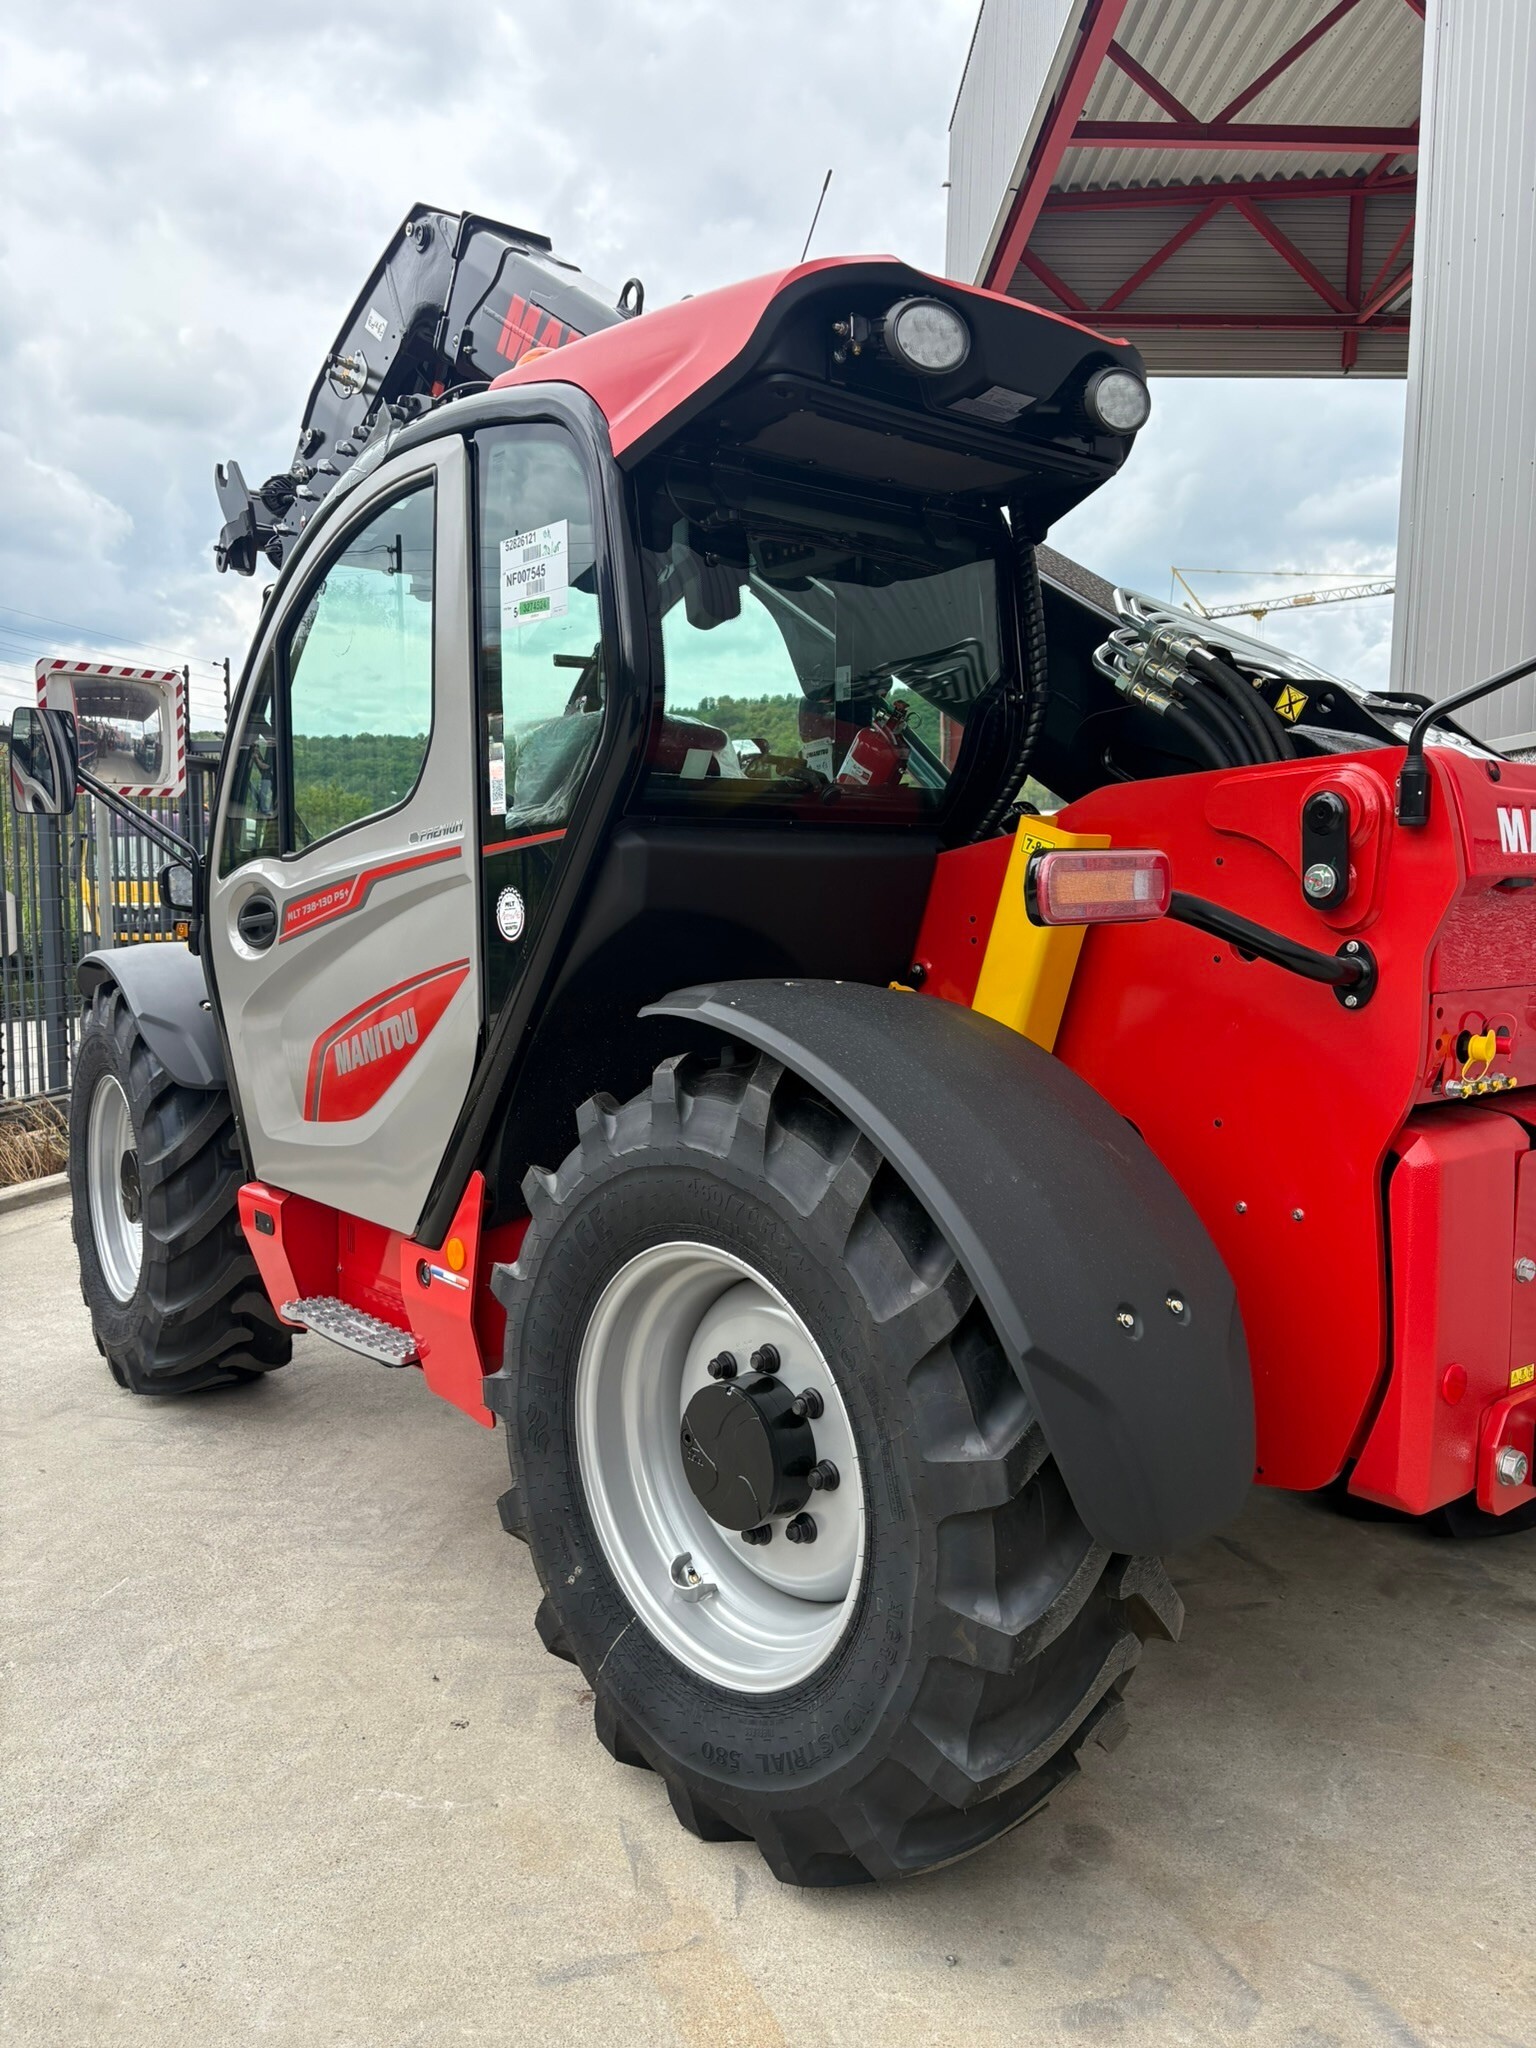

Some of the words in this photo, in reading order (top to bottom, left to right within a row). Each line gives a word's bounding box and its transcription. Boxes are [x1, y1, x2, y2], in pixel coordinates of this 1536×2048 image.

[506, 563, 546, 587] NF007545
[419, 819, 463, 842] PREMIUM
[1496, 806, 1536, 854] M
[287, 907, 302, 923] MLT
[333, 887, 350, 902] PS+
[334, 1006, 419, 1077] MANITOU
[701, 1738, 744, 1774] 580
